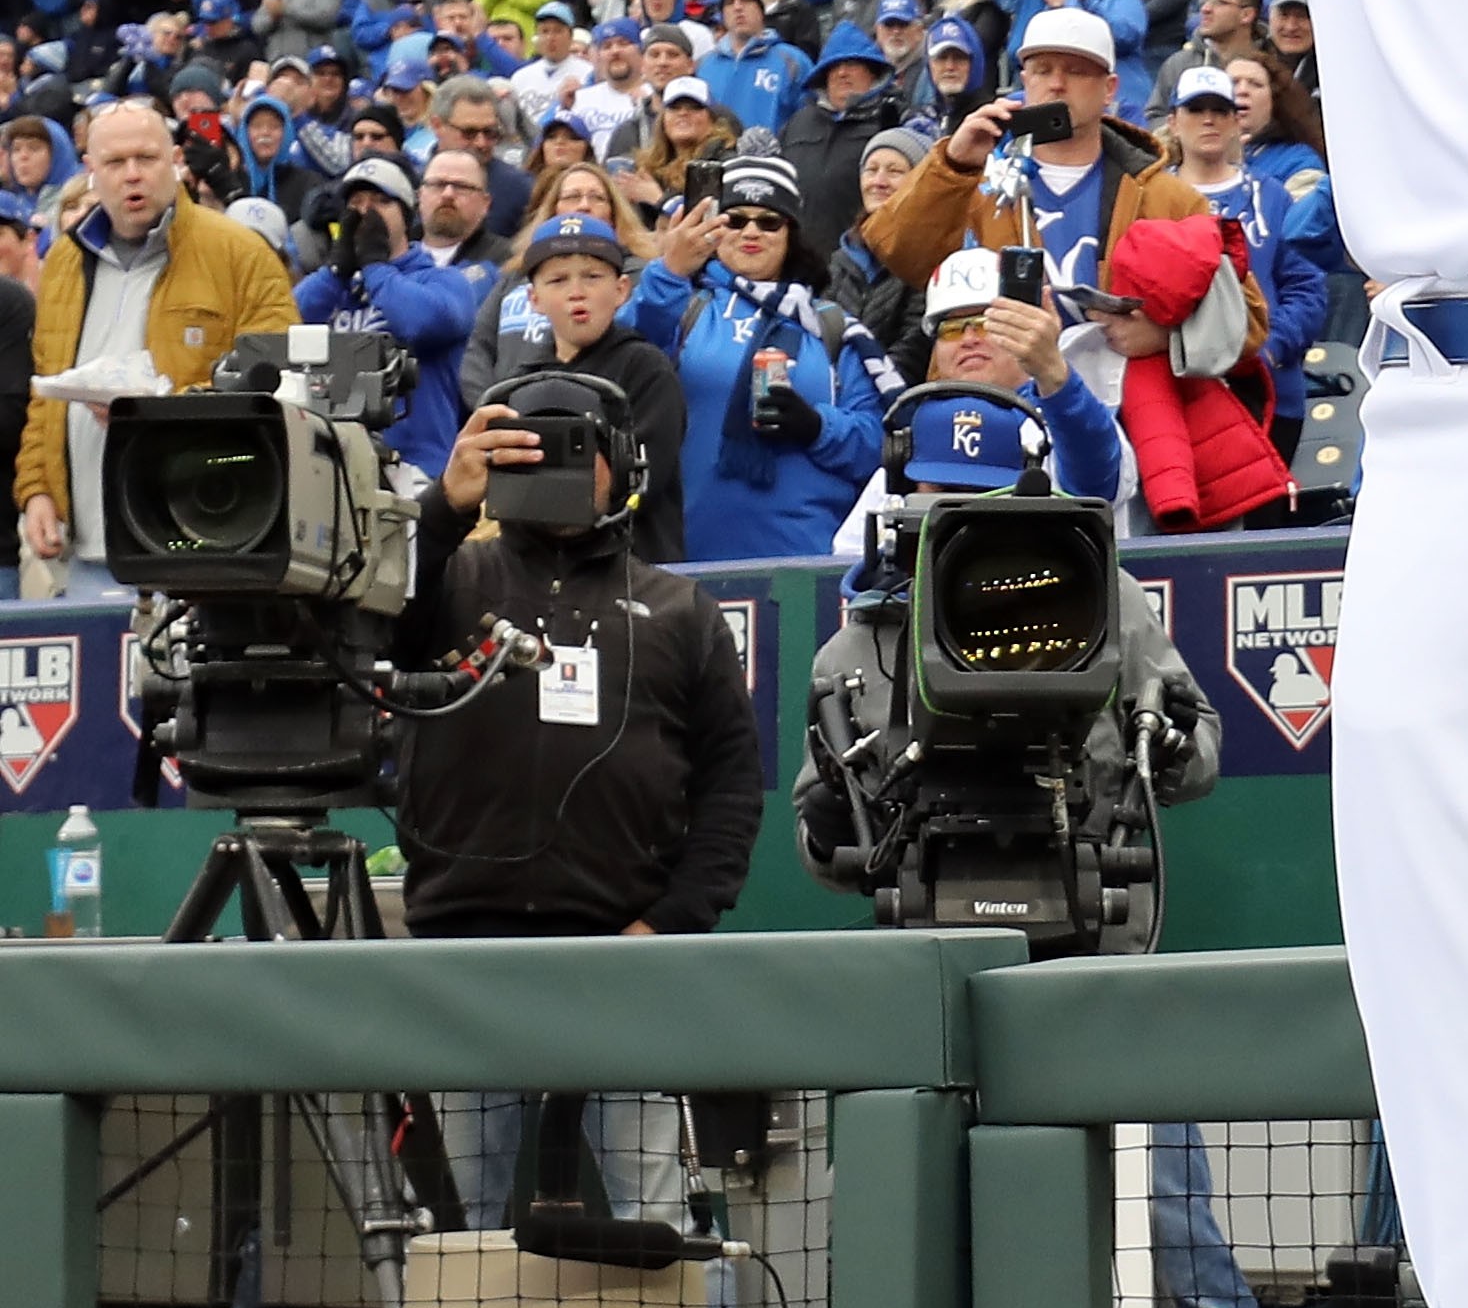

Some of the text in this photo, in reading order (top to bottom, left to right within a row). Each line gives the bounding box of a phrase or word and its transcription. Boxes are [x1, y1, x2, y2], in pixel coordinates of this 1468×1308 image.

[754, 68, 779, 92] KC
[953, 424, 981, 458] KC
[973, 901, 1029, 915] Vinten
